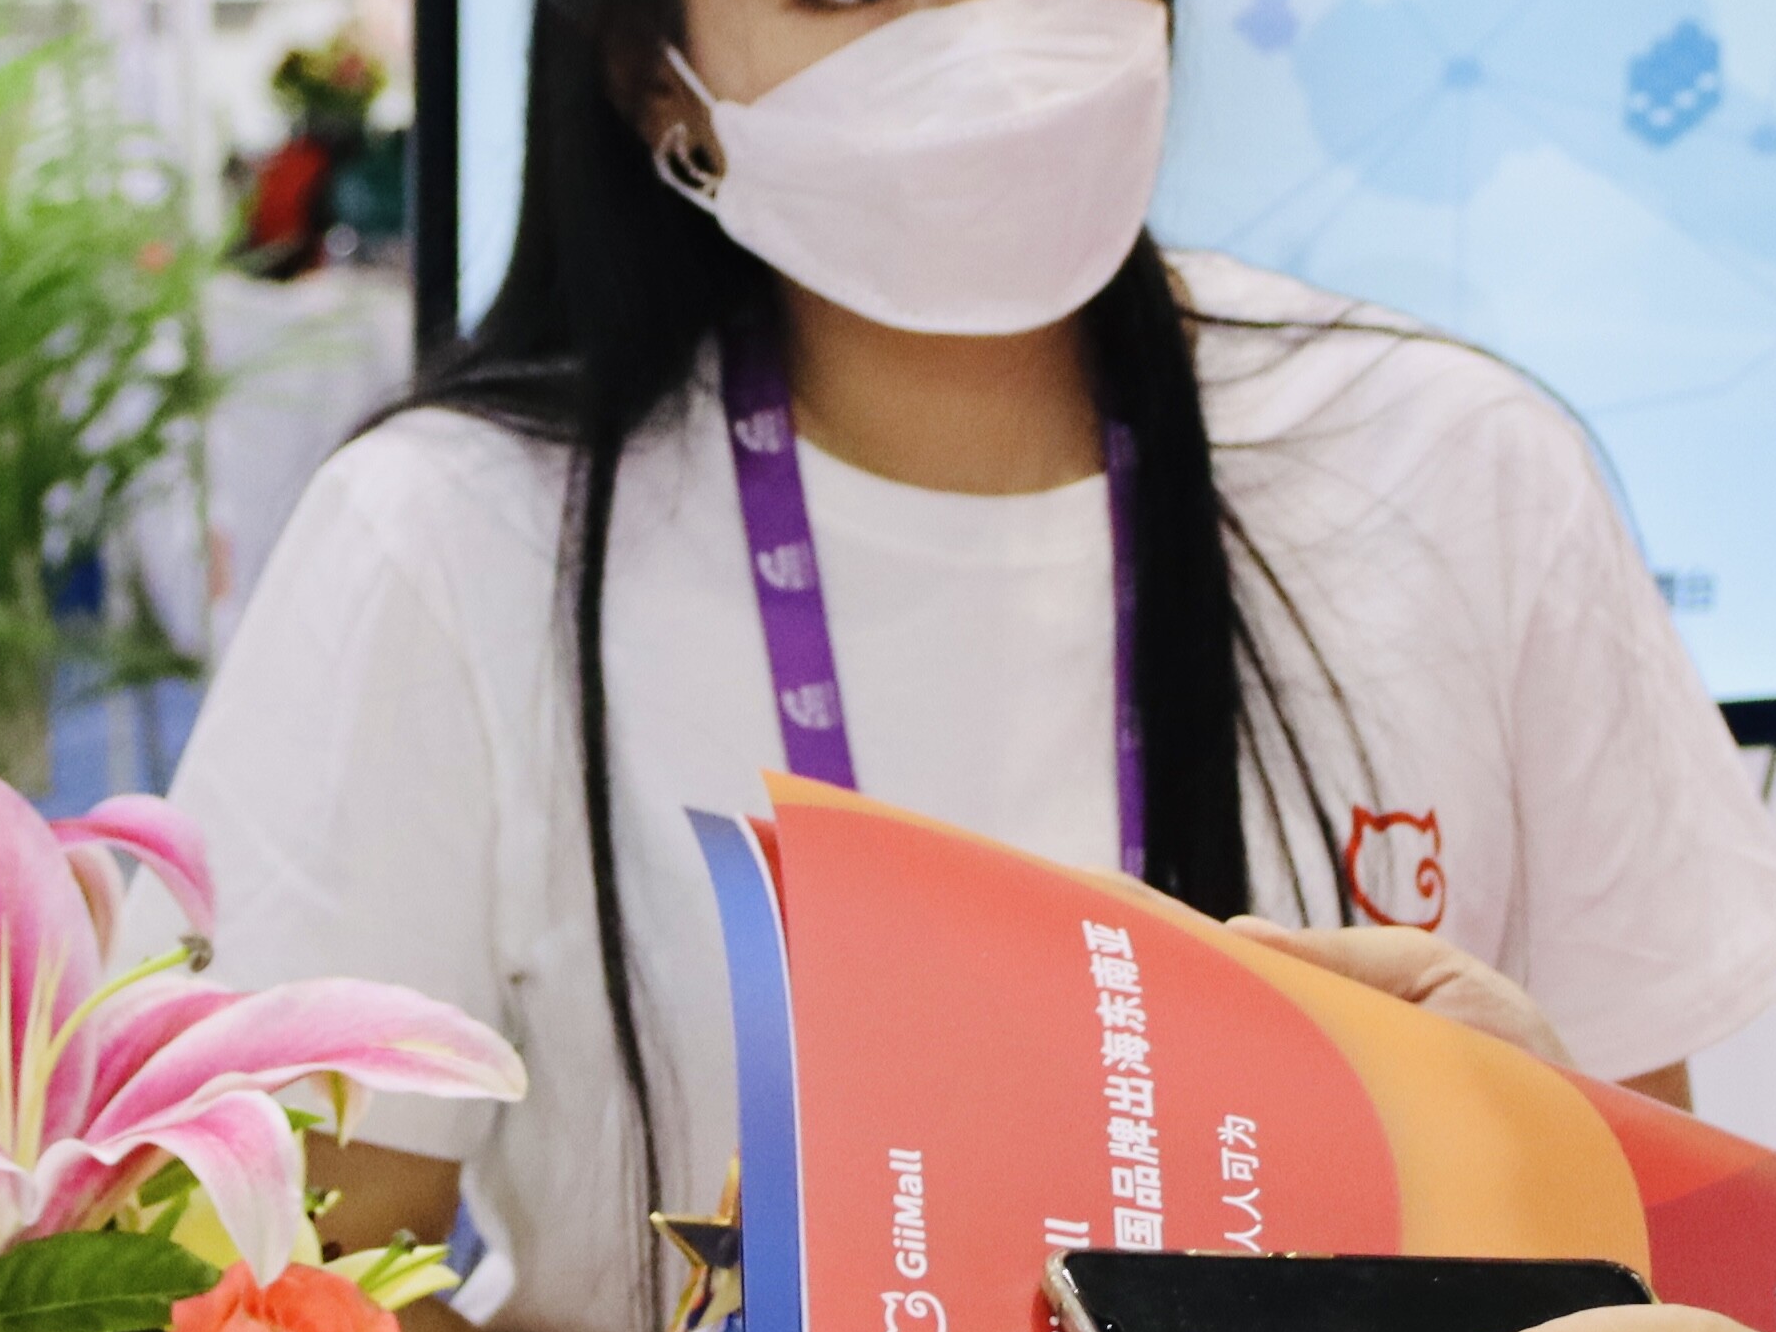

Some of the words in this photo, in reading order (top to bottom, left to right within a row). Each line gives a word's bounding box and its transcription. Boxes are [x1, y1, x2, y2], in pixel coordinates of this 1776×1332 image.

[886, 1147, 929, 1278] GiiMall
[1216, 1113, 1264, 1253] 人人可为
